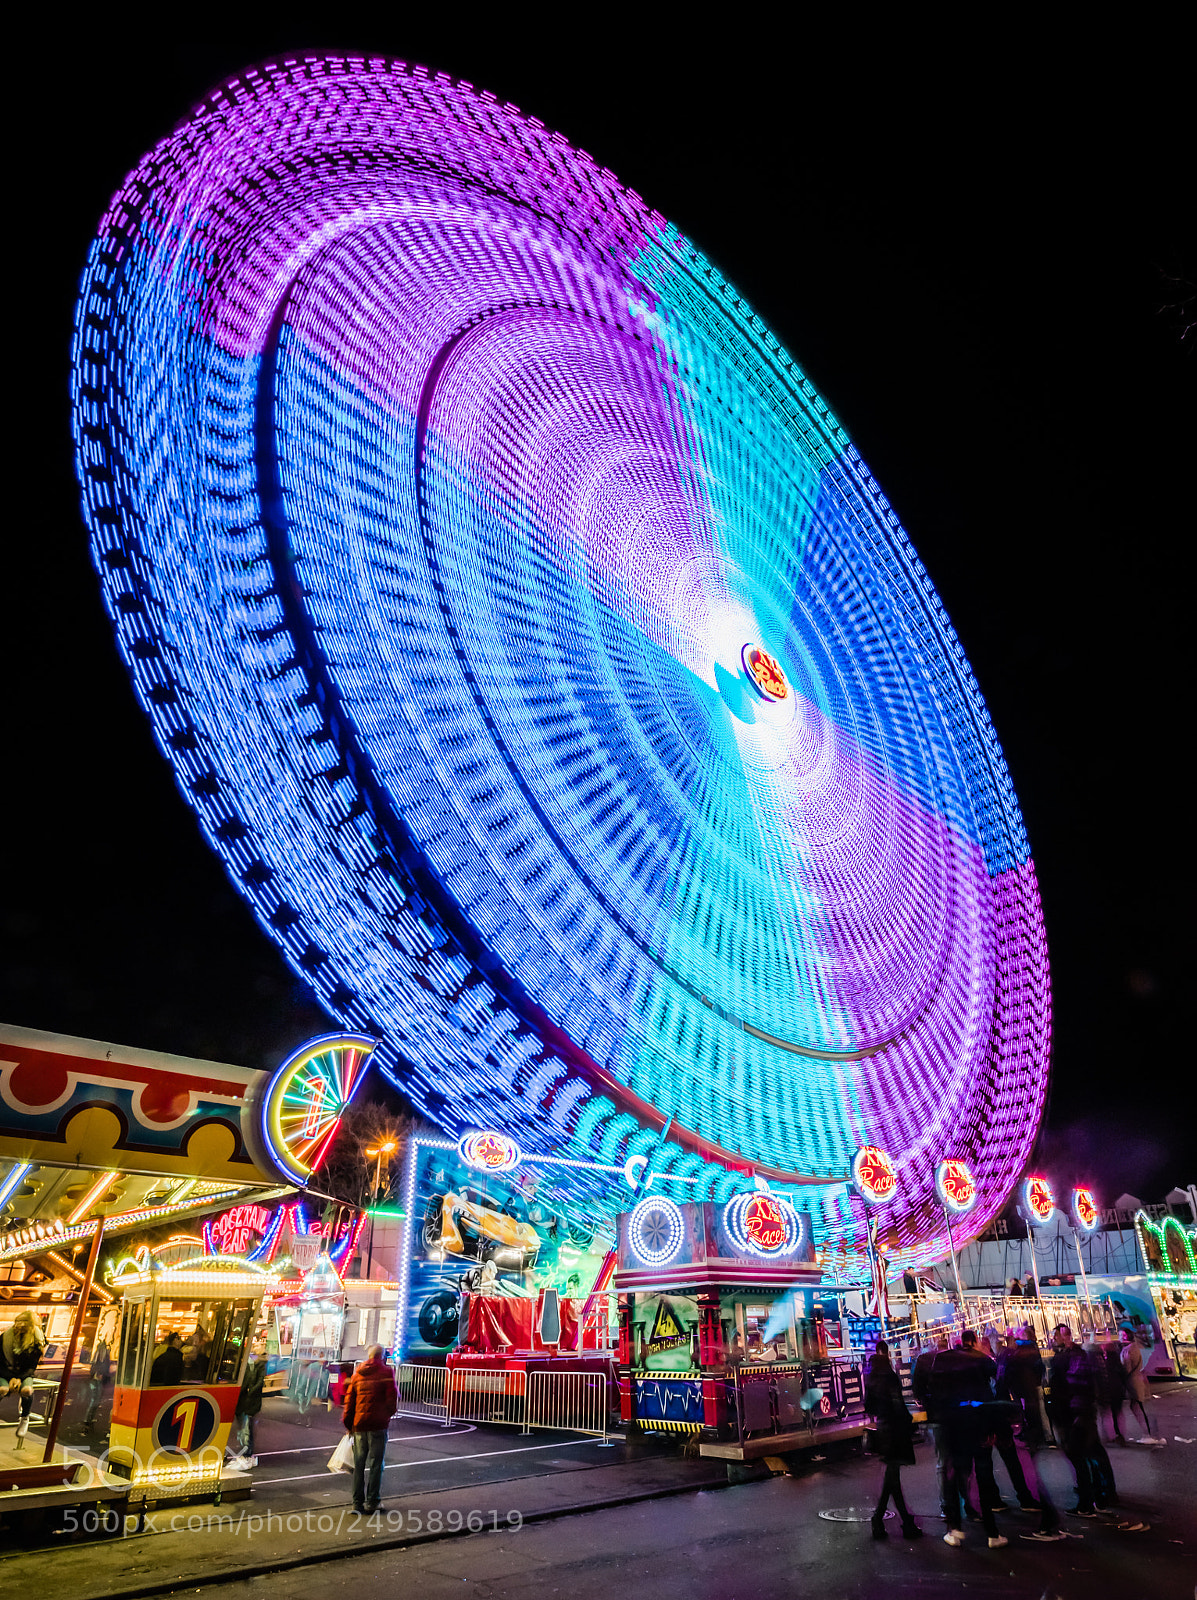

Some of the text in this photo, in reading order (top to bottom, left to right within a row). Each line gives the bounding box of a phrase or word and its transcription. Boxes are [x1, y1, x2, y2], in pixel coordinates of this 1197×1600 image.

[221, 1228, 250, 1255] BAR
[746, 1216, 788, 1243] Racer
[201, 1260, 240, 1272] KASSE
[171, 1399, 199, 1452] 1
